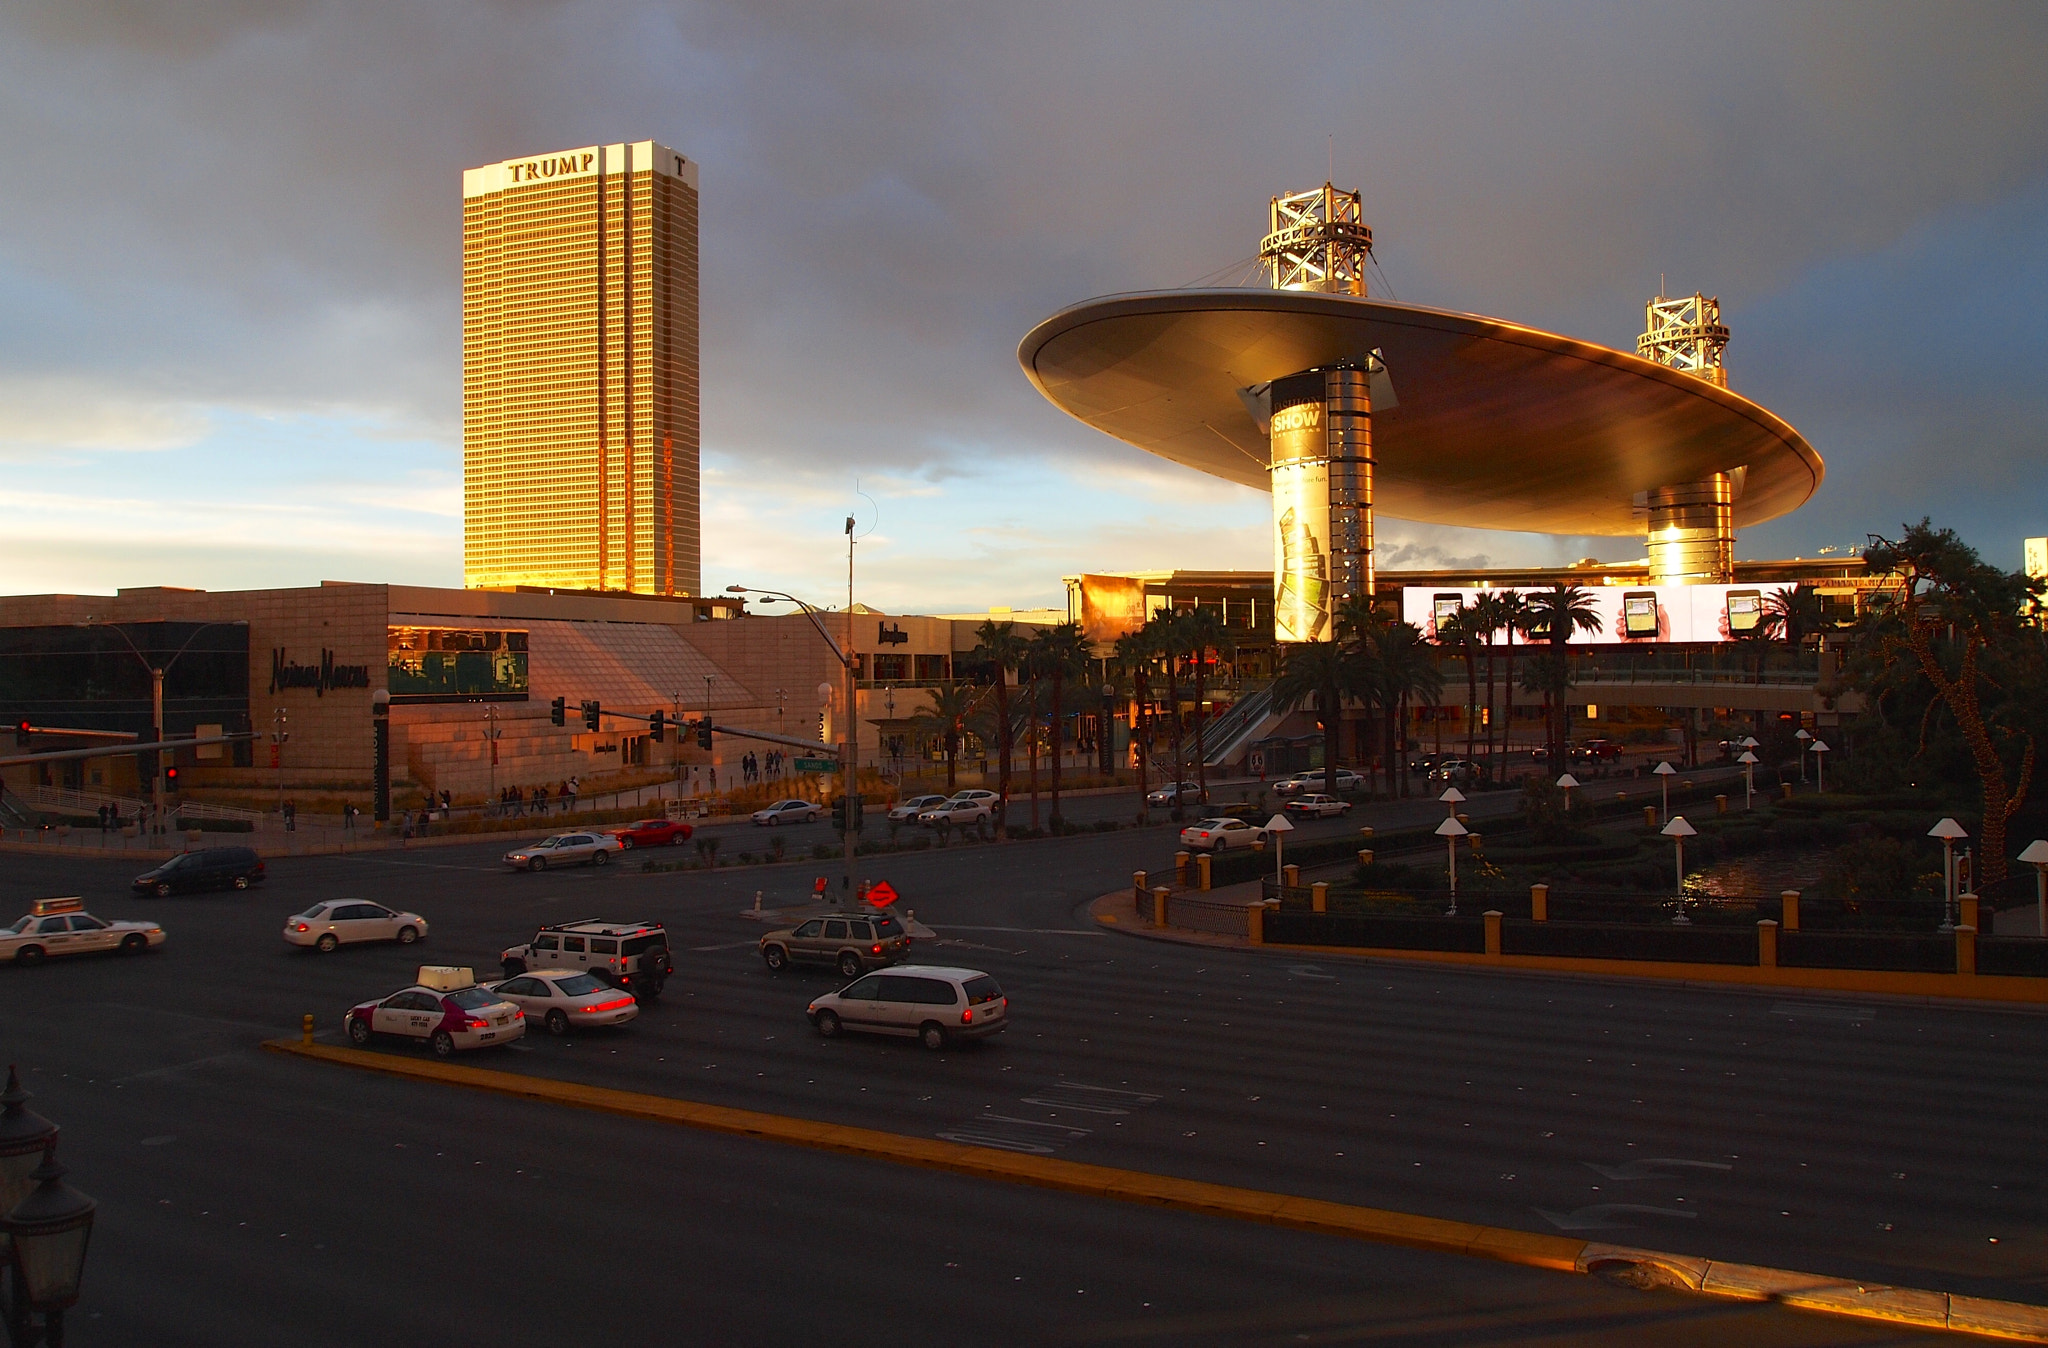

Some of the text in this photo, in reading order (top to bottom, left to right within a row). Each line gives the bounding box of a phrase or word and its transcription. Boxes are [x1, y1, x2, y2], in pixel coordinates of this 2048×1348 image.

[508, 153, 594, 182] TRUMP
[674, 155, 686, 177] T
[1274, 411, 1320, 433] SHOW
